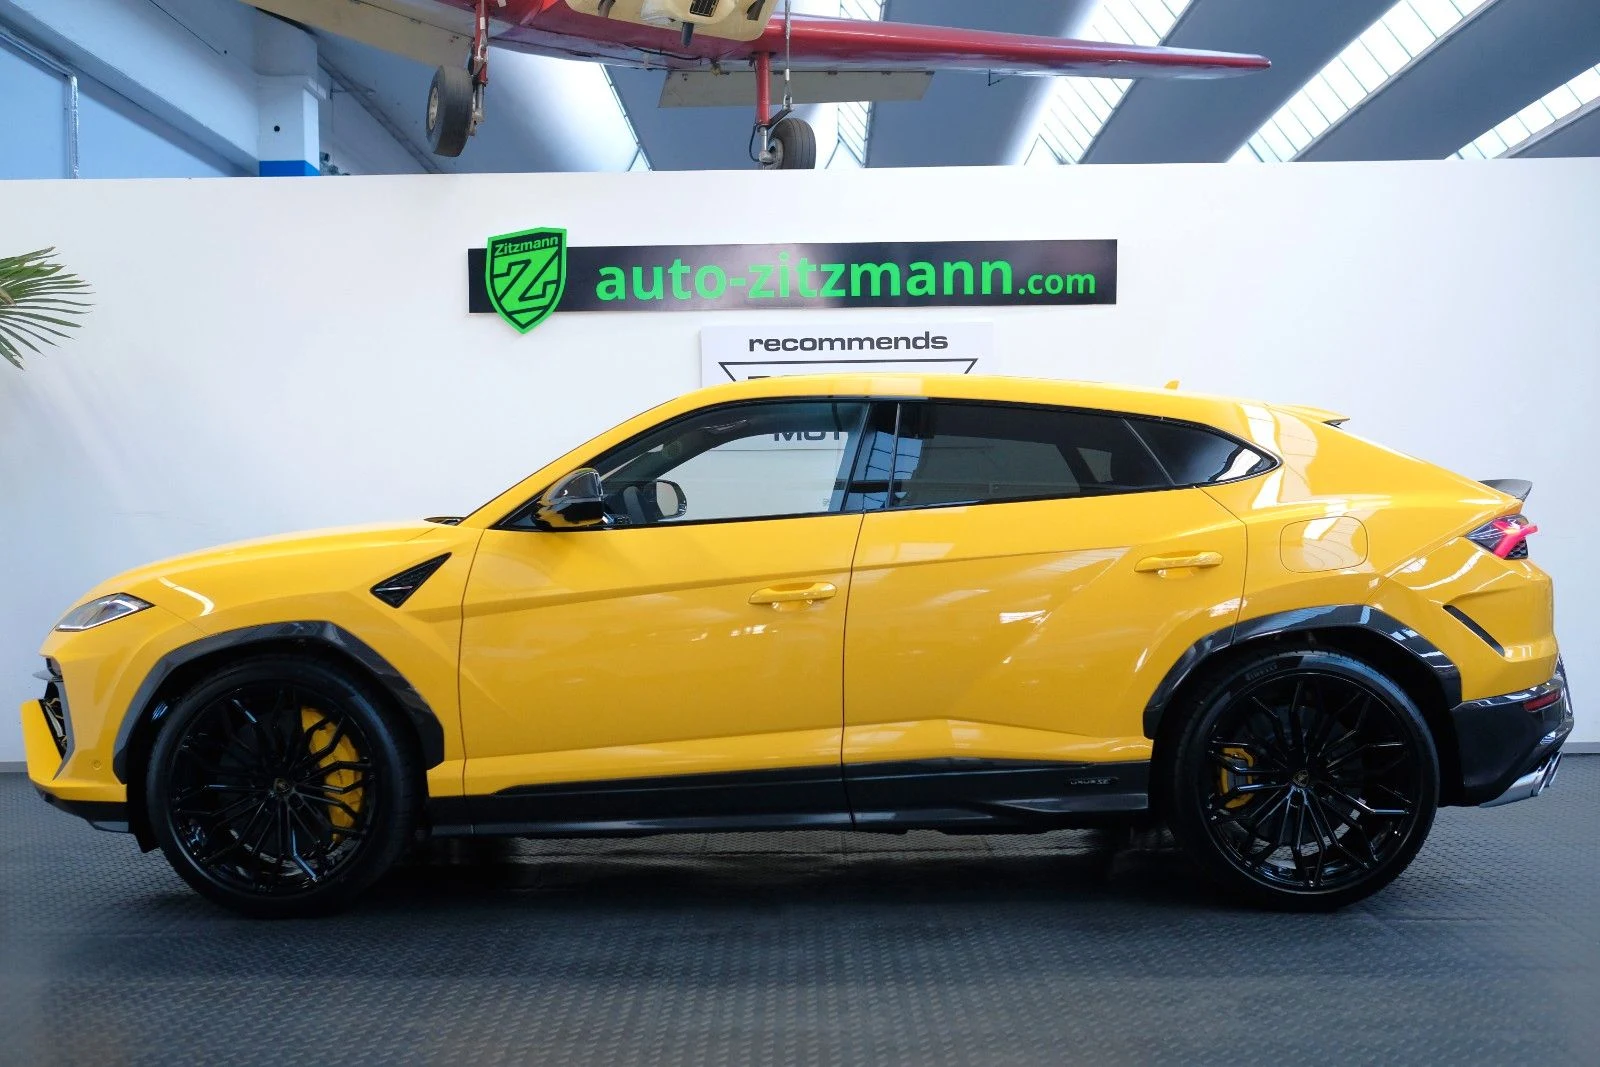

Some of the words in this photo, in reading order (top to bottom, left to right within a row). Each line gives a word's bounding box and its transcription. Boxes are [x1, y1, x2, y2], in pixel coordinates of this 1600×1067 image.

[494, 236, 559, 256] Zitzmann
[595, 252, 1096, 301] auto-zitzmann.com
[749, 331, 949, 352] recommends
